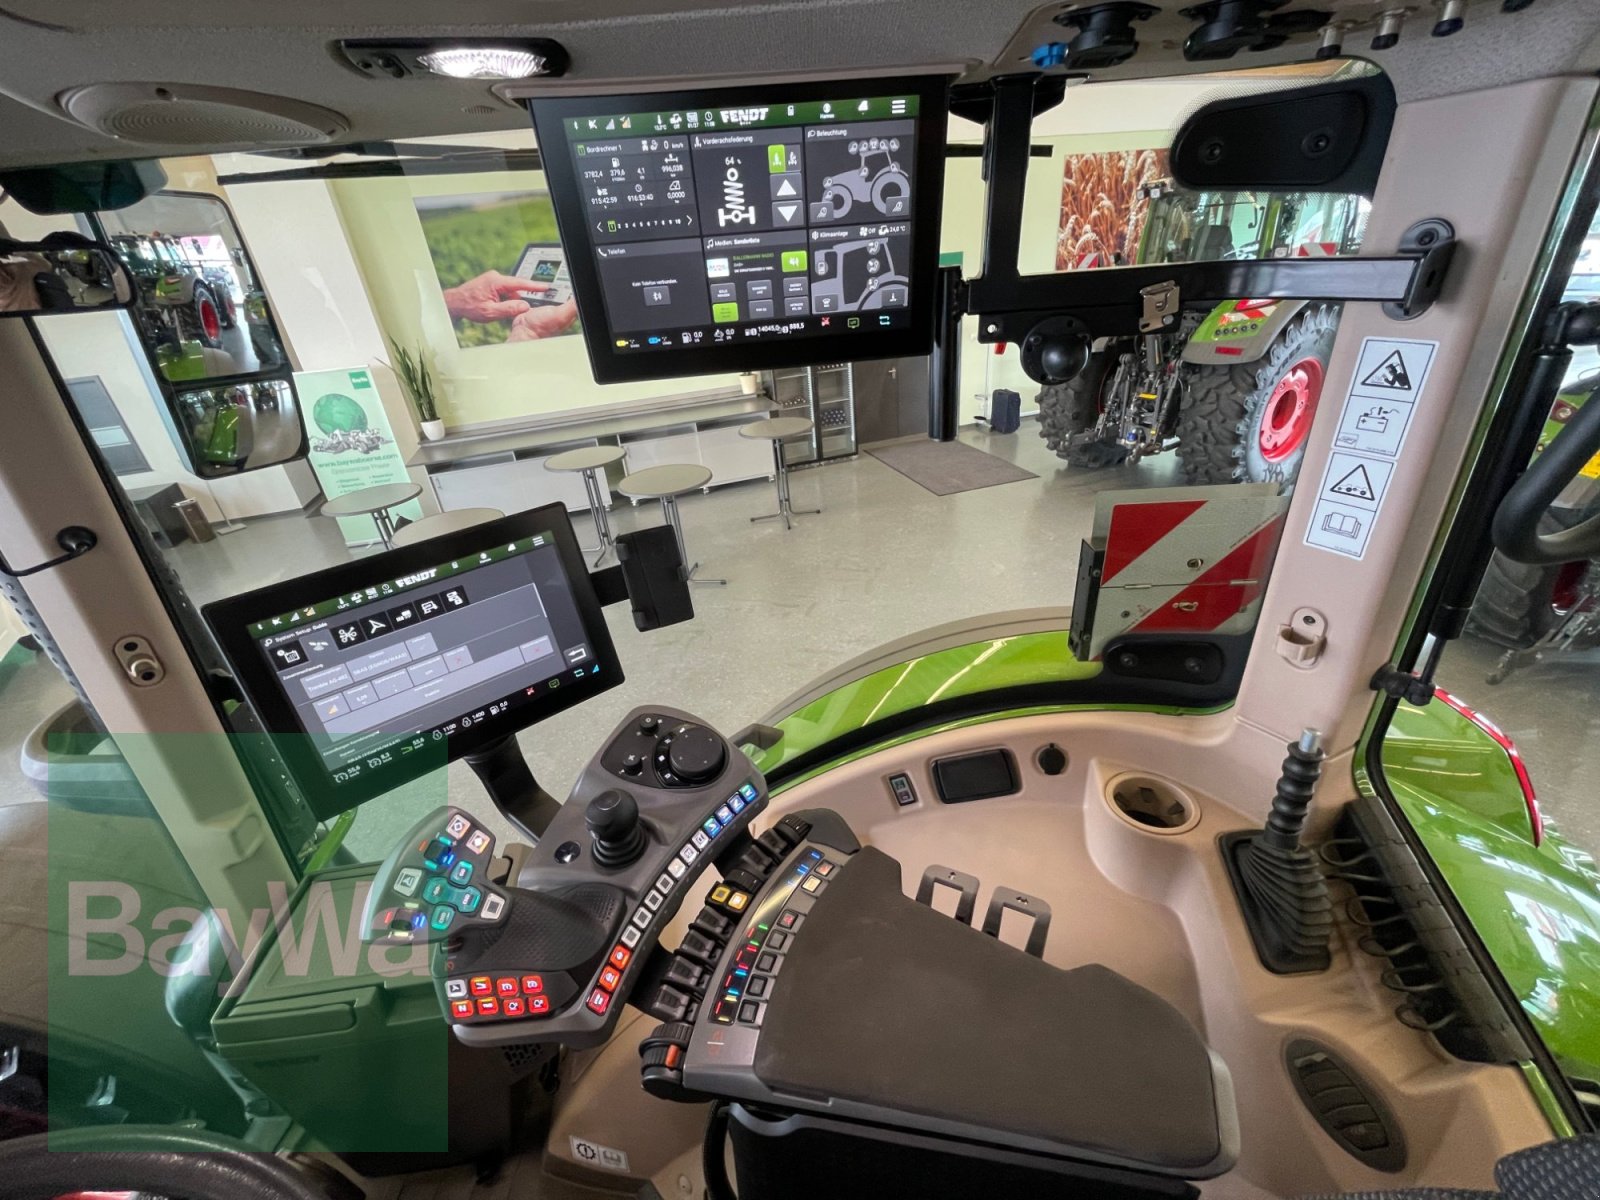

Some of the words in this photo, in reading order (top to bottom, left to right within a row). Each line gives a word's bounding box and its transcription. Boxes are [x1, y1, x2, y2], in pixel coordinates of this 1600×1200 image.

[720, 108, 769, 123] FENDT
[816, 129, 848, 137] Beleuchtung
[702, 135, 753, 145] Vorderachsfederung
[586, 145, 617, 153] Bordrechner
[725, 156, 735, 165] 64
[820, 230, 848, 238] Klimaanlage
[395, 568, 437, 588] FENDT
